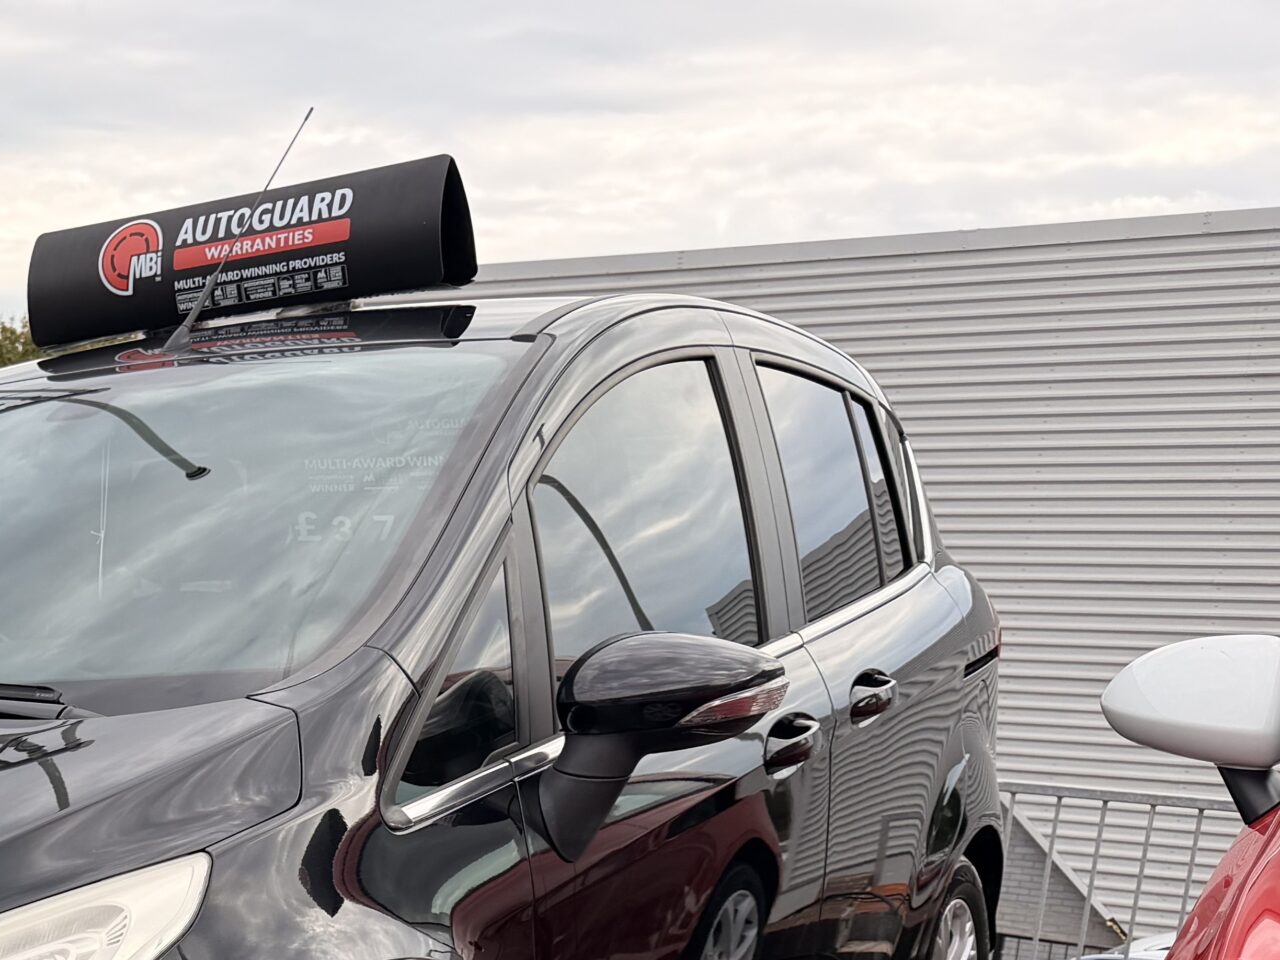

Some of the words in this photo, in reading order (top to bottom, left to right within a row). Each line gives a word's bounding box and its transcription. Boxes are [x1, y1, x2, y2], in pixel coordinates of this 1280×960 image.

[175, 187, 354, 247] AUTOGUARD
[204, 229, 313, 261] WARRANTIES
[242, 262, 288, 279] WINNING
[288, 252, 346, 273] PROVIDERS
[304, 456, 406, 470] MULTI-AWARD
